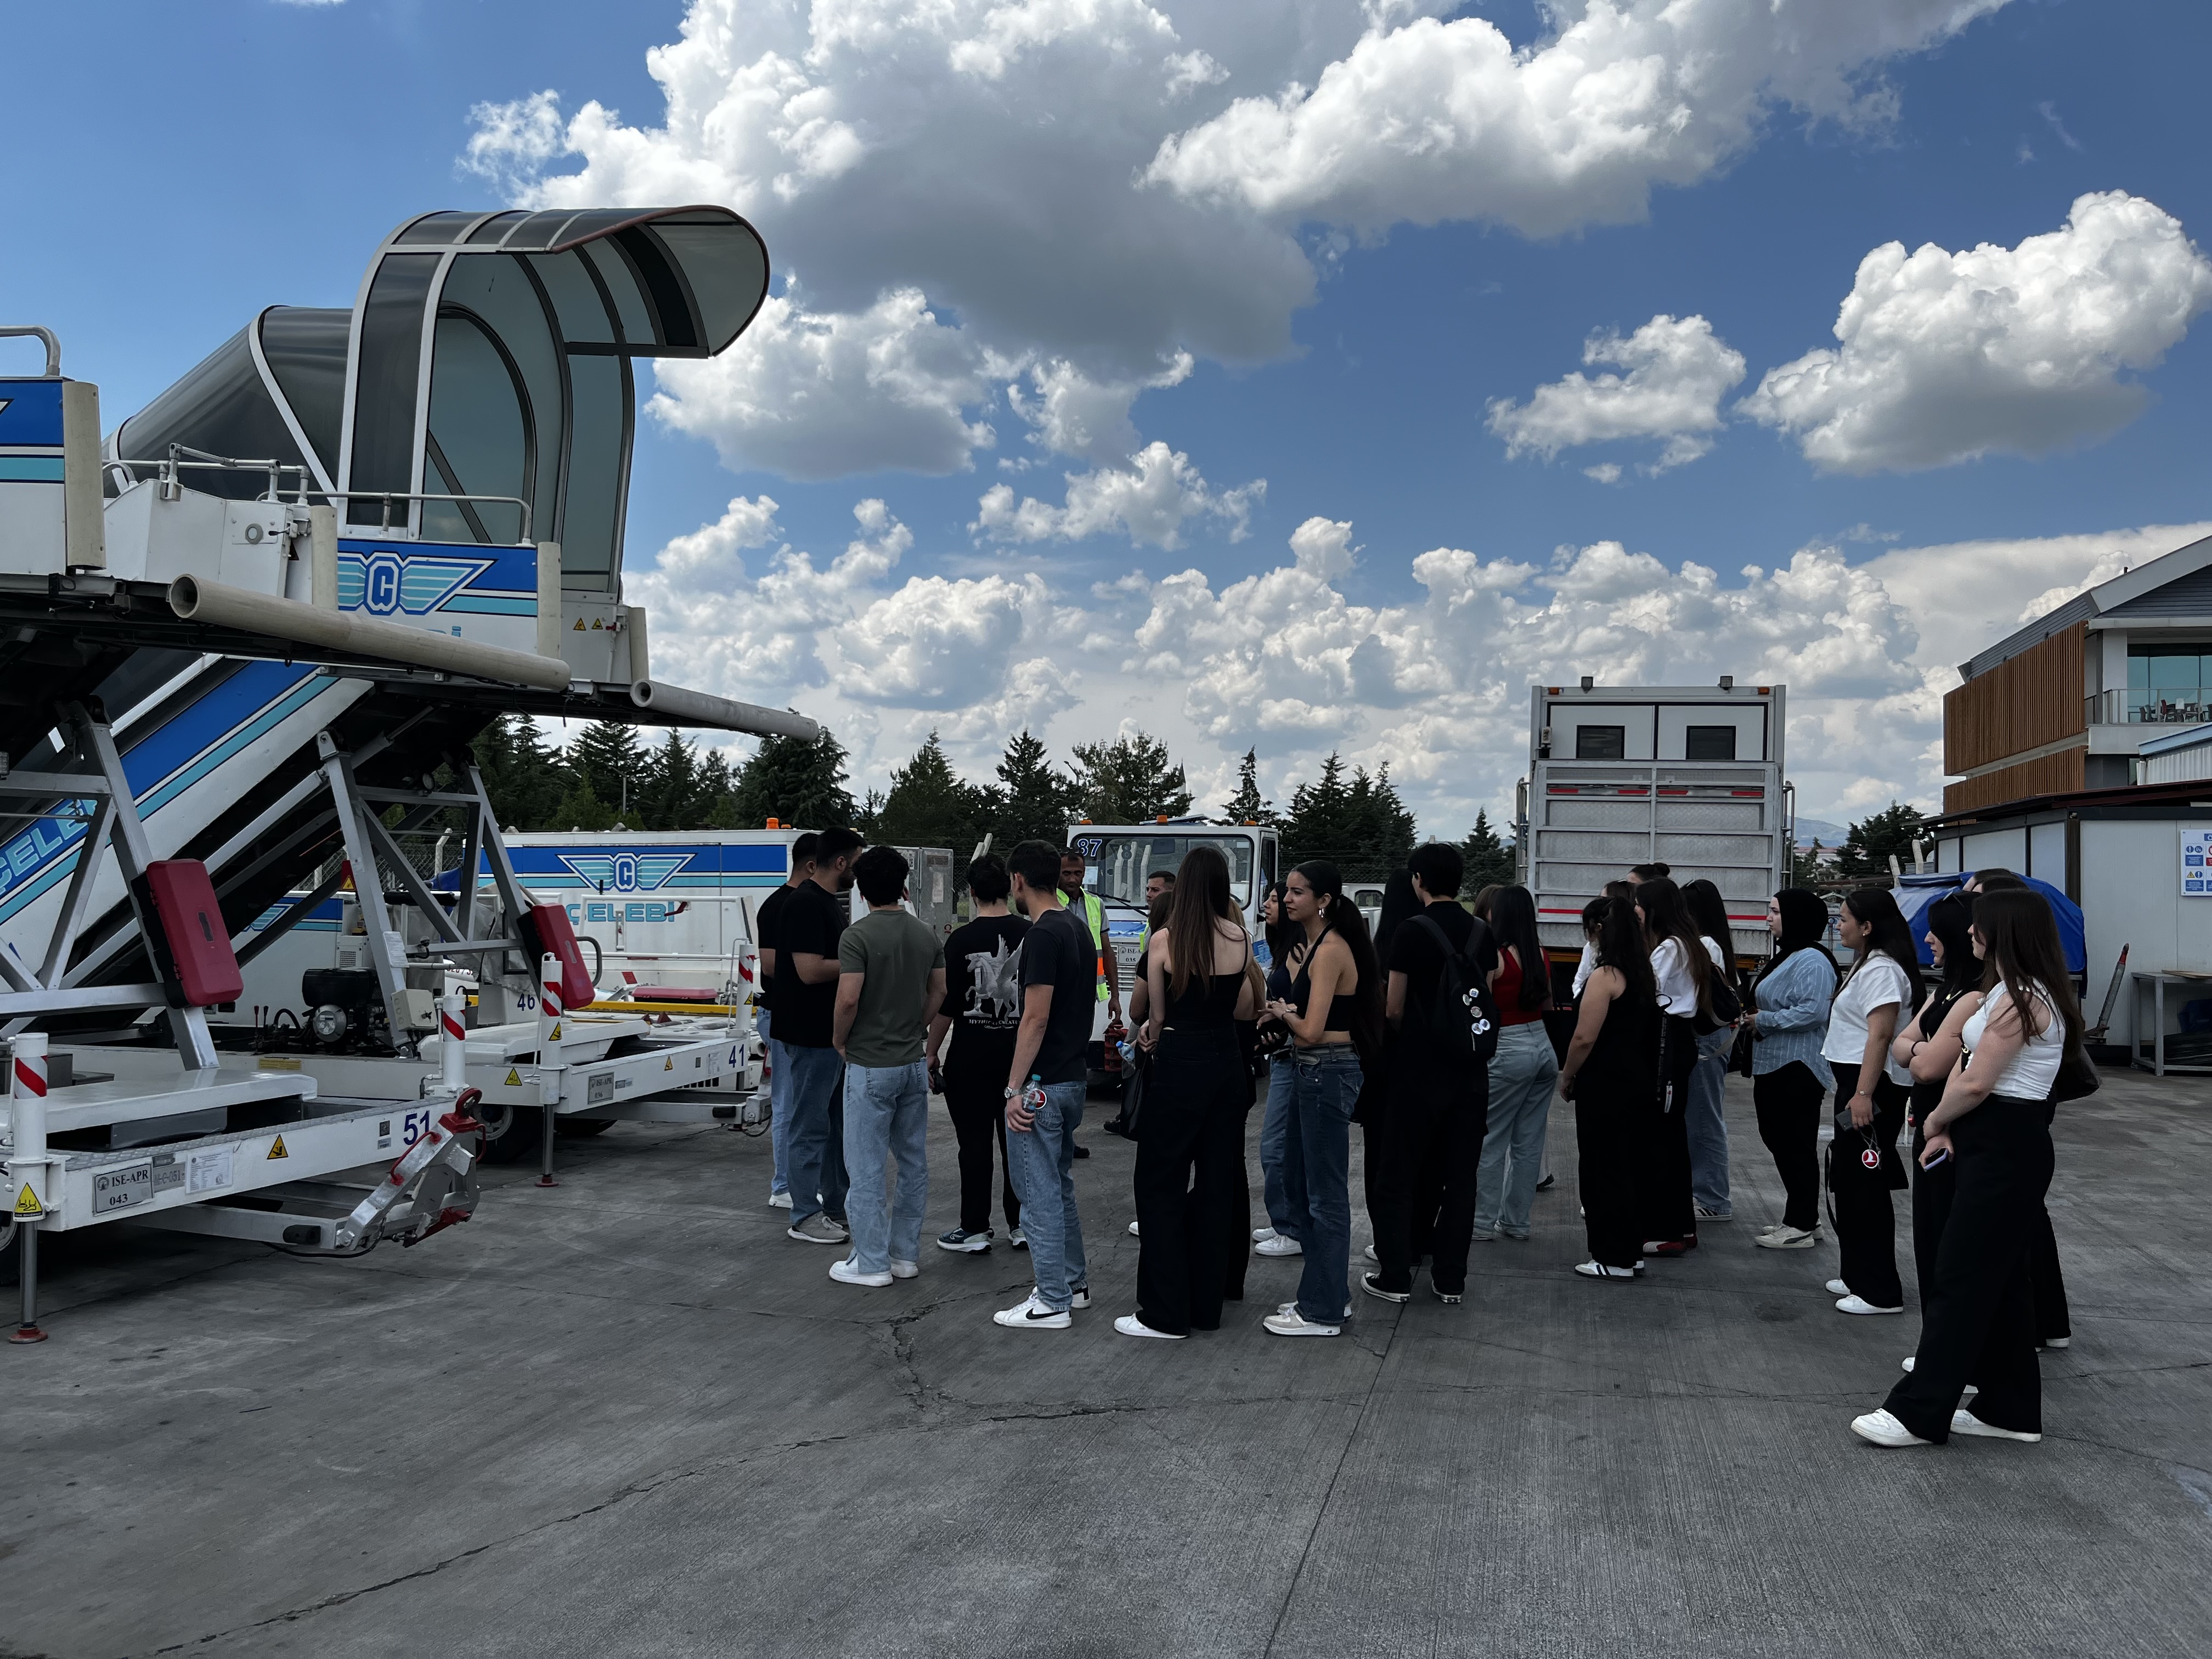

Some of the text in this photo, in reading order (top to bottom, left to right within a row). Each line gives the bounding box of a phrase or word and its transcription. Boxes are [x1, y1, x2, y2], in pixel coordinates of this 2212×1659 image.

[1077, 838, 1103, 857] 87
[517, 993, 535, 1011] 46
[729, 1044, 744, 1068] 41
[403, 1110, 430, 1146] 51
[111, 1169, 149, 1187] ISE-APR
[110, 1193, 128, 1206] 043
